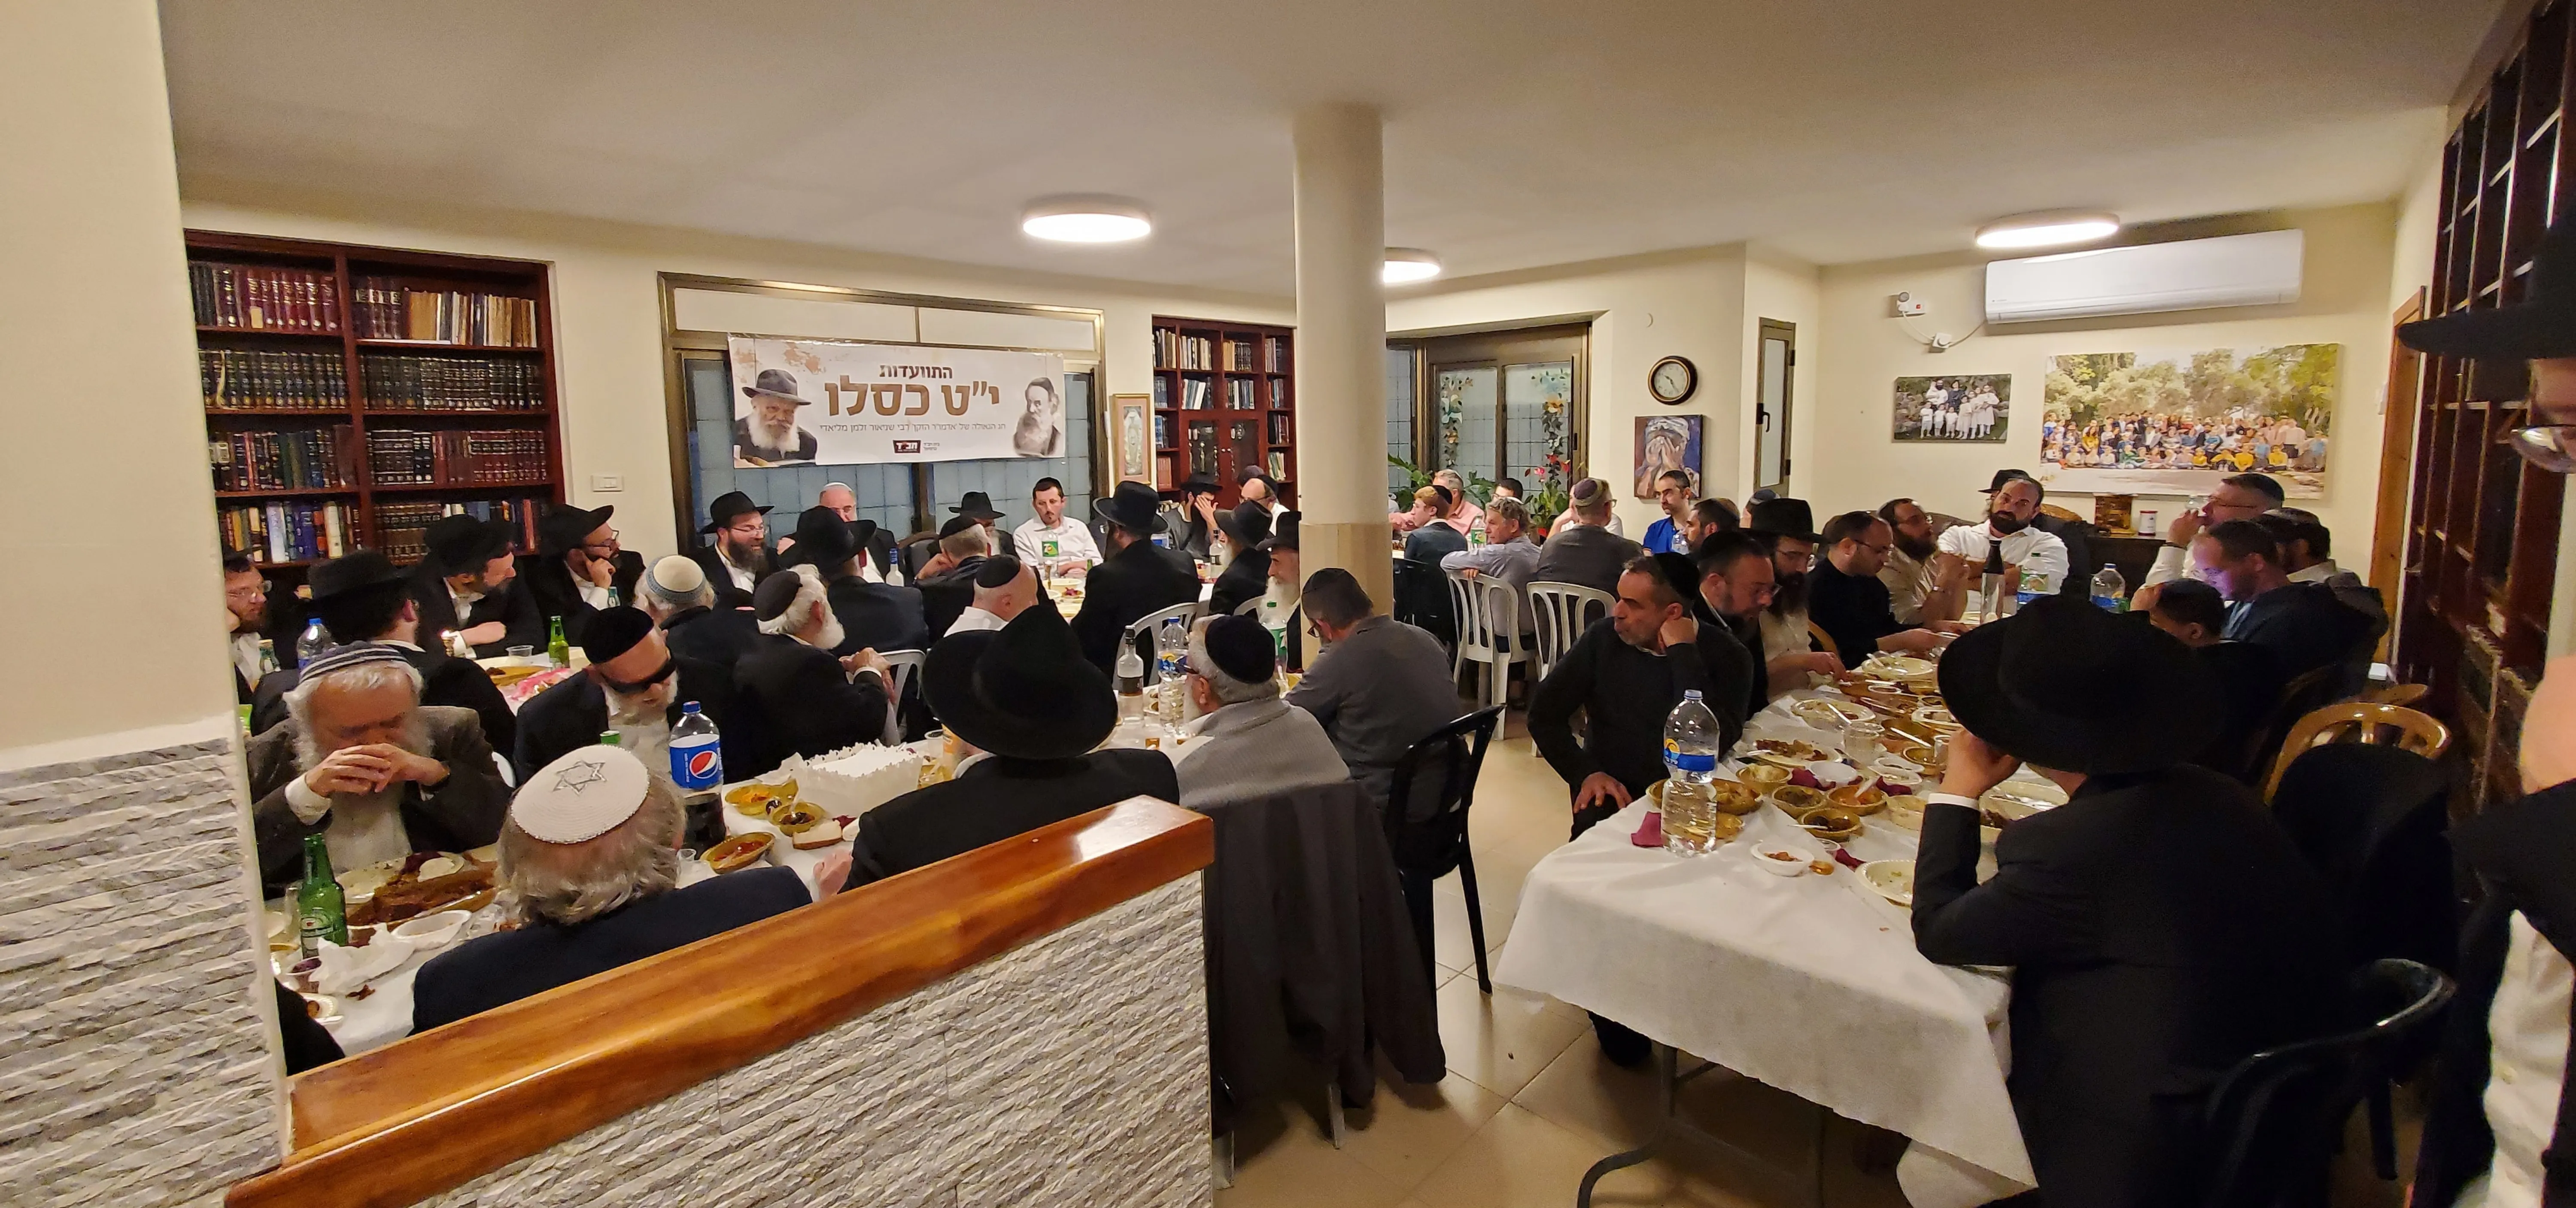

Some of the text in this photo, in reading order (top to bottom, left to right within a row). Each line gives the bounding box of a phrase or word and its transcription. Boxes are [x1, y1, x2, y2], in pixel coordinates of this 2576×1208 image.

[879, 365, 952, 379] התוועדות
[824, 375, 999, 416] י"ט כסלו
[820, 423, 848, 432] מליאדי
[851, 424, 867, 432] זלמן
